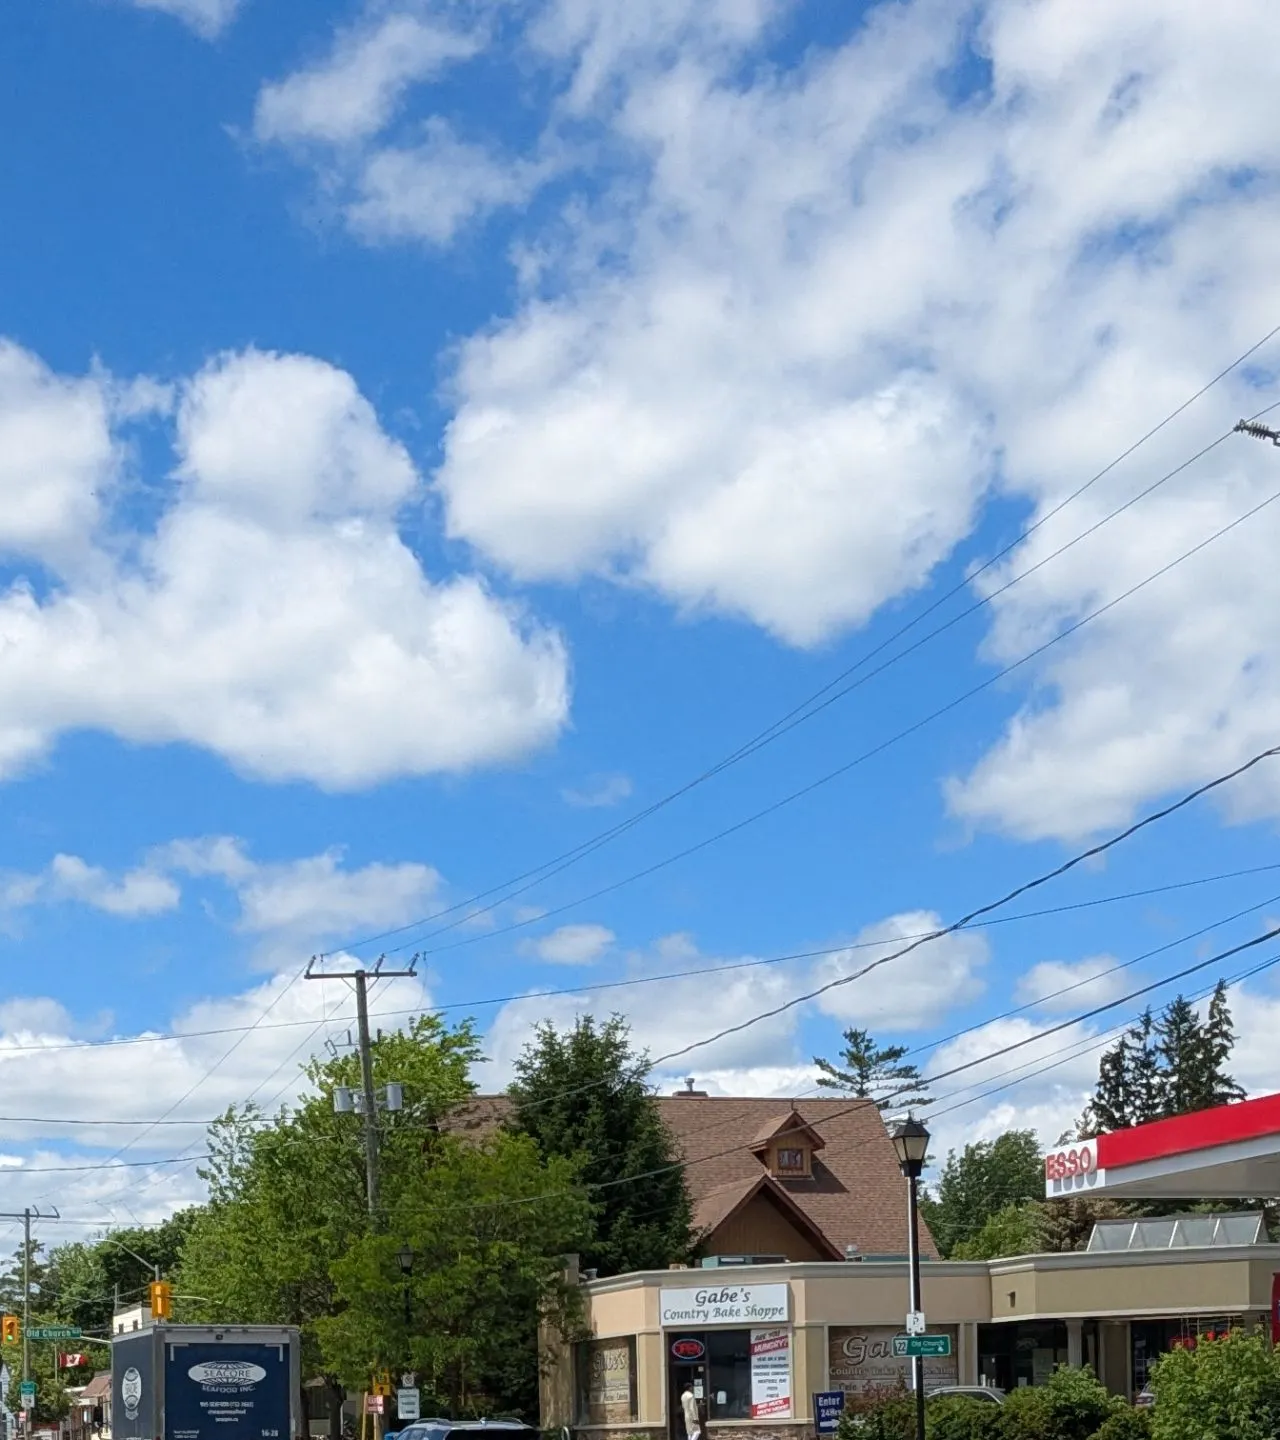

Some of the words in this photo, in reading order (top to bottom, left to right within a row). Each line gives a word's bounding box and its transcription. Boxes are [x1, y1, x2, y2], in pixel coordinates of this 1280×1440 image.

[1046, 1146, 1091, 1180] ESSO
[695, 1287, 751, 1306] Gabe's
[663, 1309, 709, 1322] Country
[713, 1307, 740, 1318] Bake
[744, 1304, 784, 1320] Shoppe
[26, 1329, 40, 1338] Old
[42, 1328, 72, 1338] Church
[897, 1341, 907, 1352] 22
[203, 1370, 251, 1378] SEACORE
[818, 1397, 840, 1406] Enter
